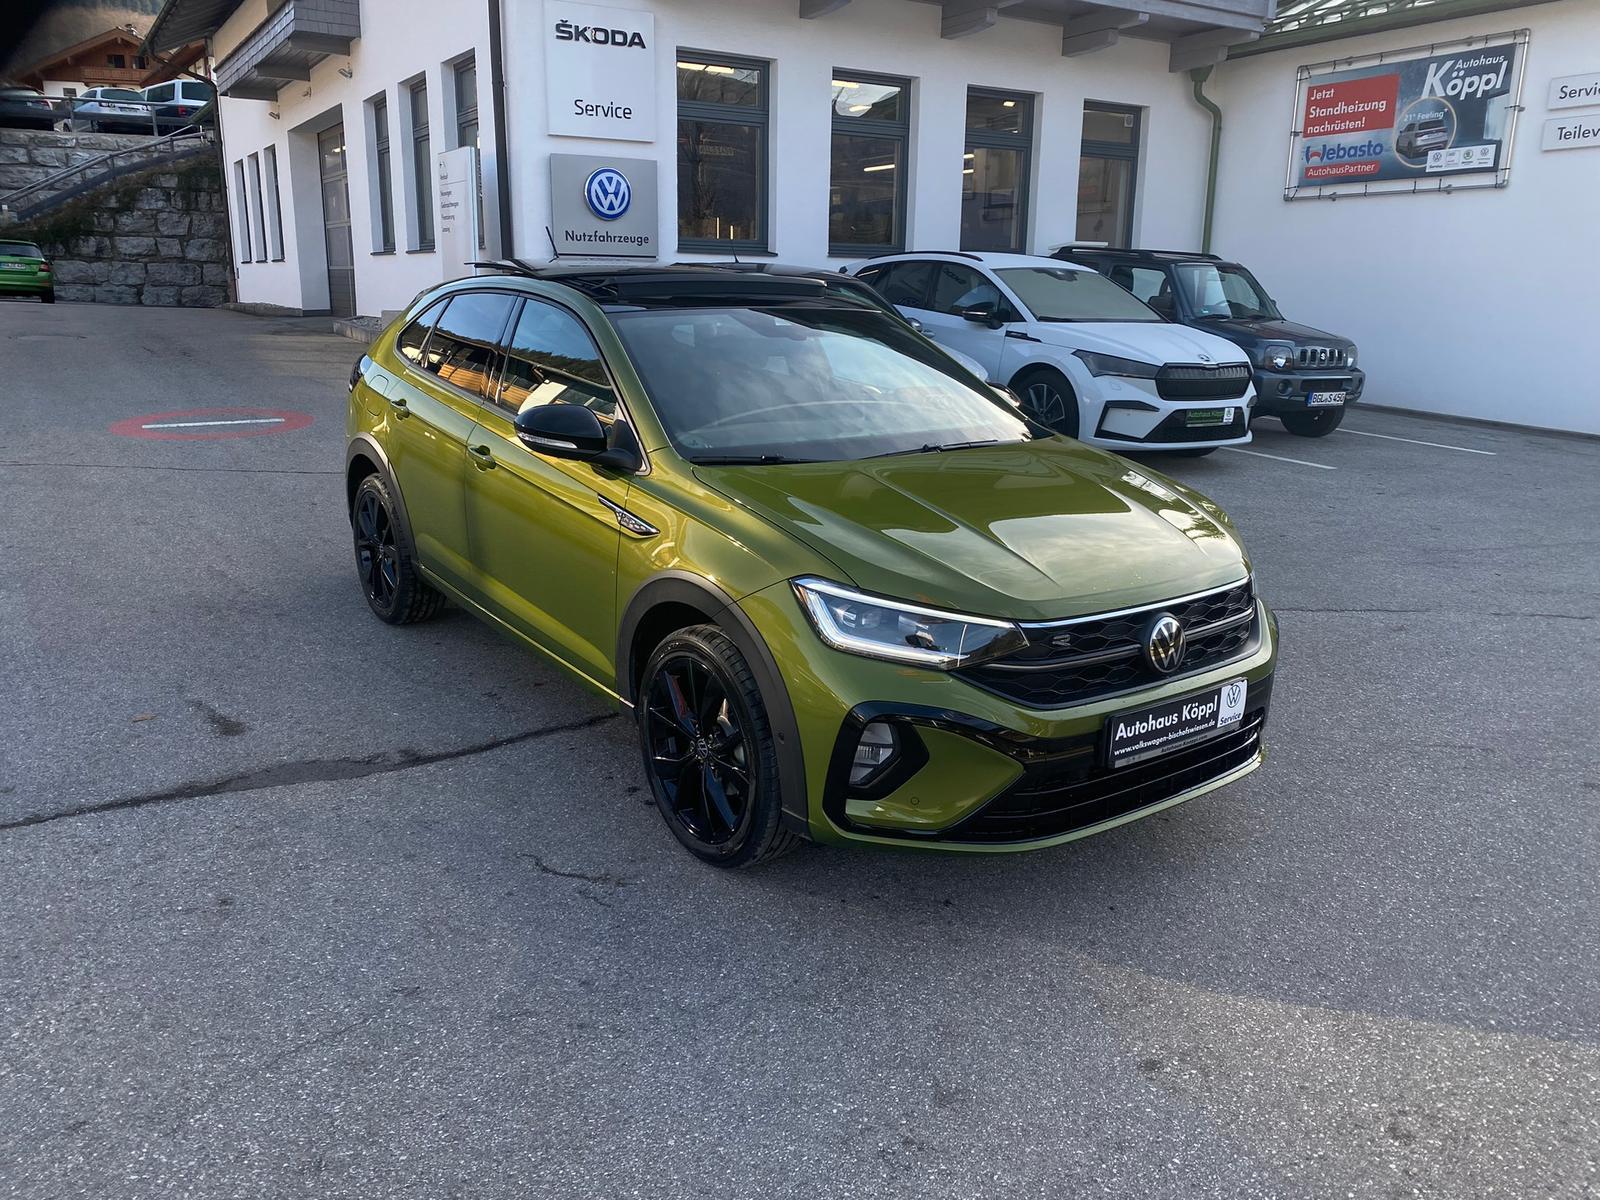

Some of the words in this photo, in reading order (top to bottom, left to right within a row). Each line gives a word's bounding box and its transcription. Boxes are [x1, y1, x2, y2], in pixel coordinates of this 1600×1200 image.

[555, 19, 646, 49] ŠKODA
[1454, 55, 1505, 69] Autohaus
[1421, 60, 1508, 100] Köppl
[1311, 88, 1334, 100] Jetzt
[574, 99, 632, 119] Service
[1309, 100, 1387, 118] Standheizung
[1307, 117, 1365, 134] nachrüsten!
[1557, 124, 1600, 140] Teilev
[1305, 140, 1384, 164] Webasto
[1308, 164, 1375, 176] AutohausPartner
[565, 230, 649, 246] Nutzfahrzeuge
[1115, 714, 1178, 740] Autohaus
[1182, 695, 1218, 721] Köppl
[1220, 712, 1241, 725] Service
